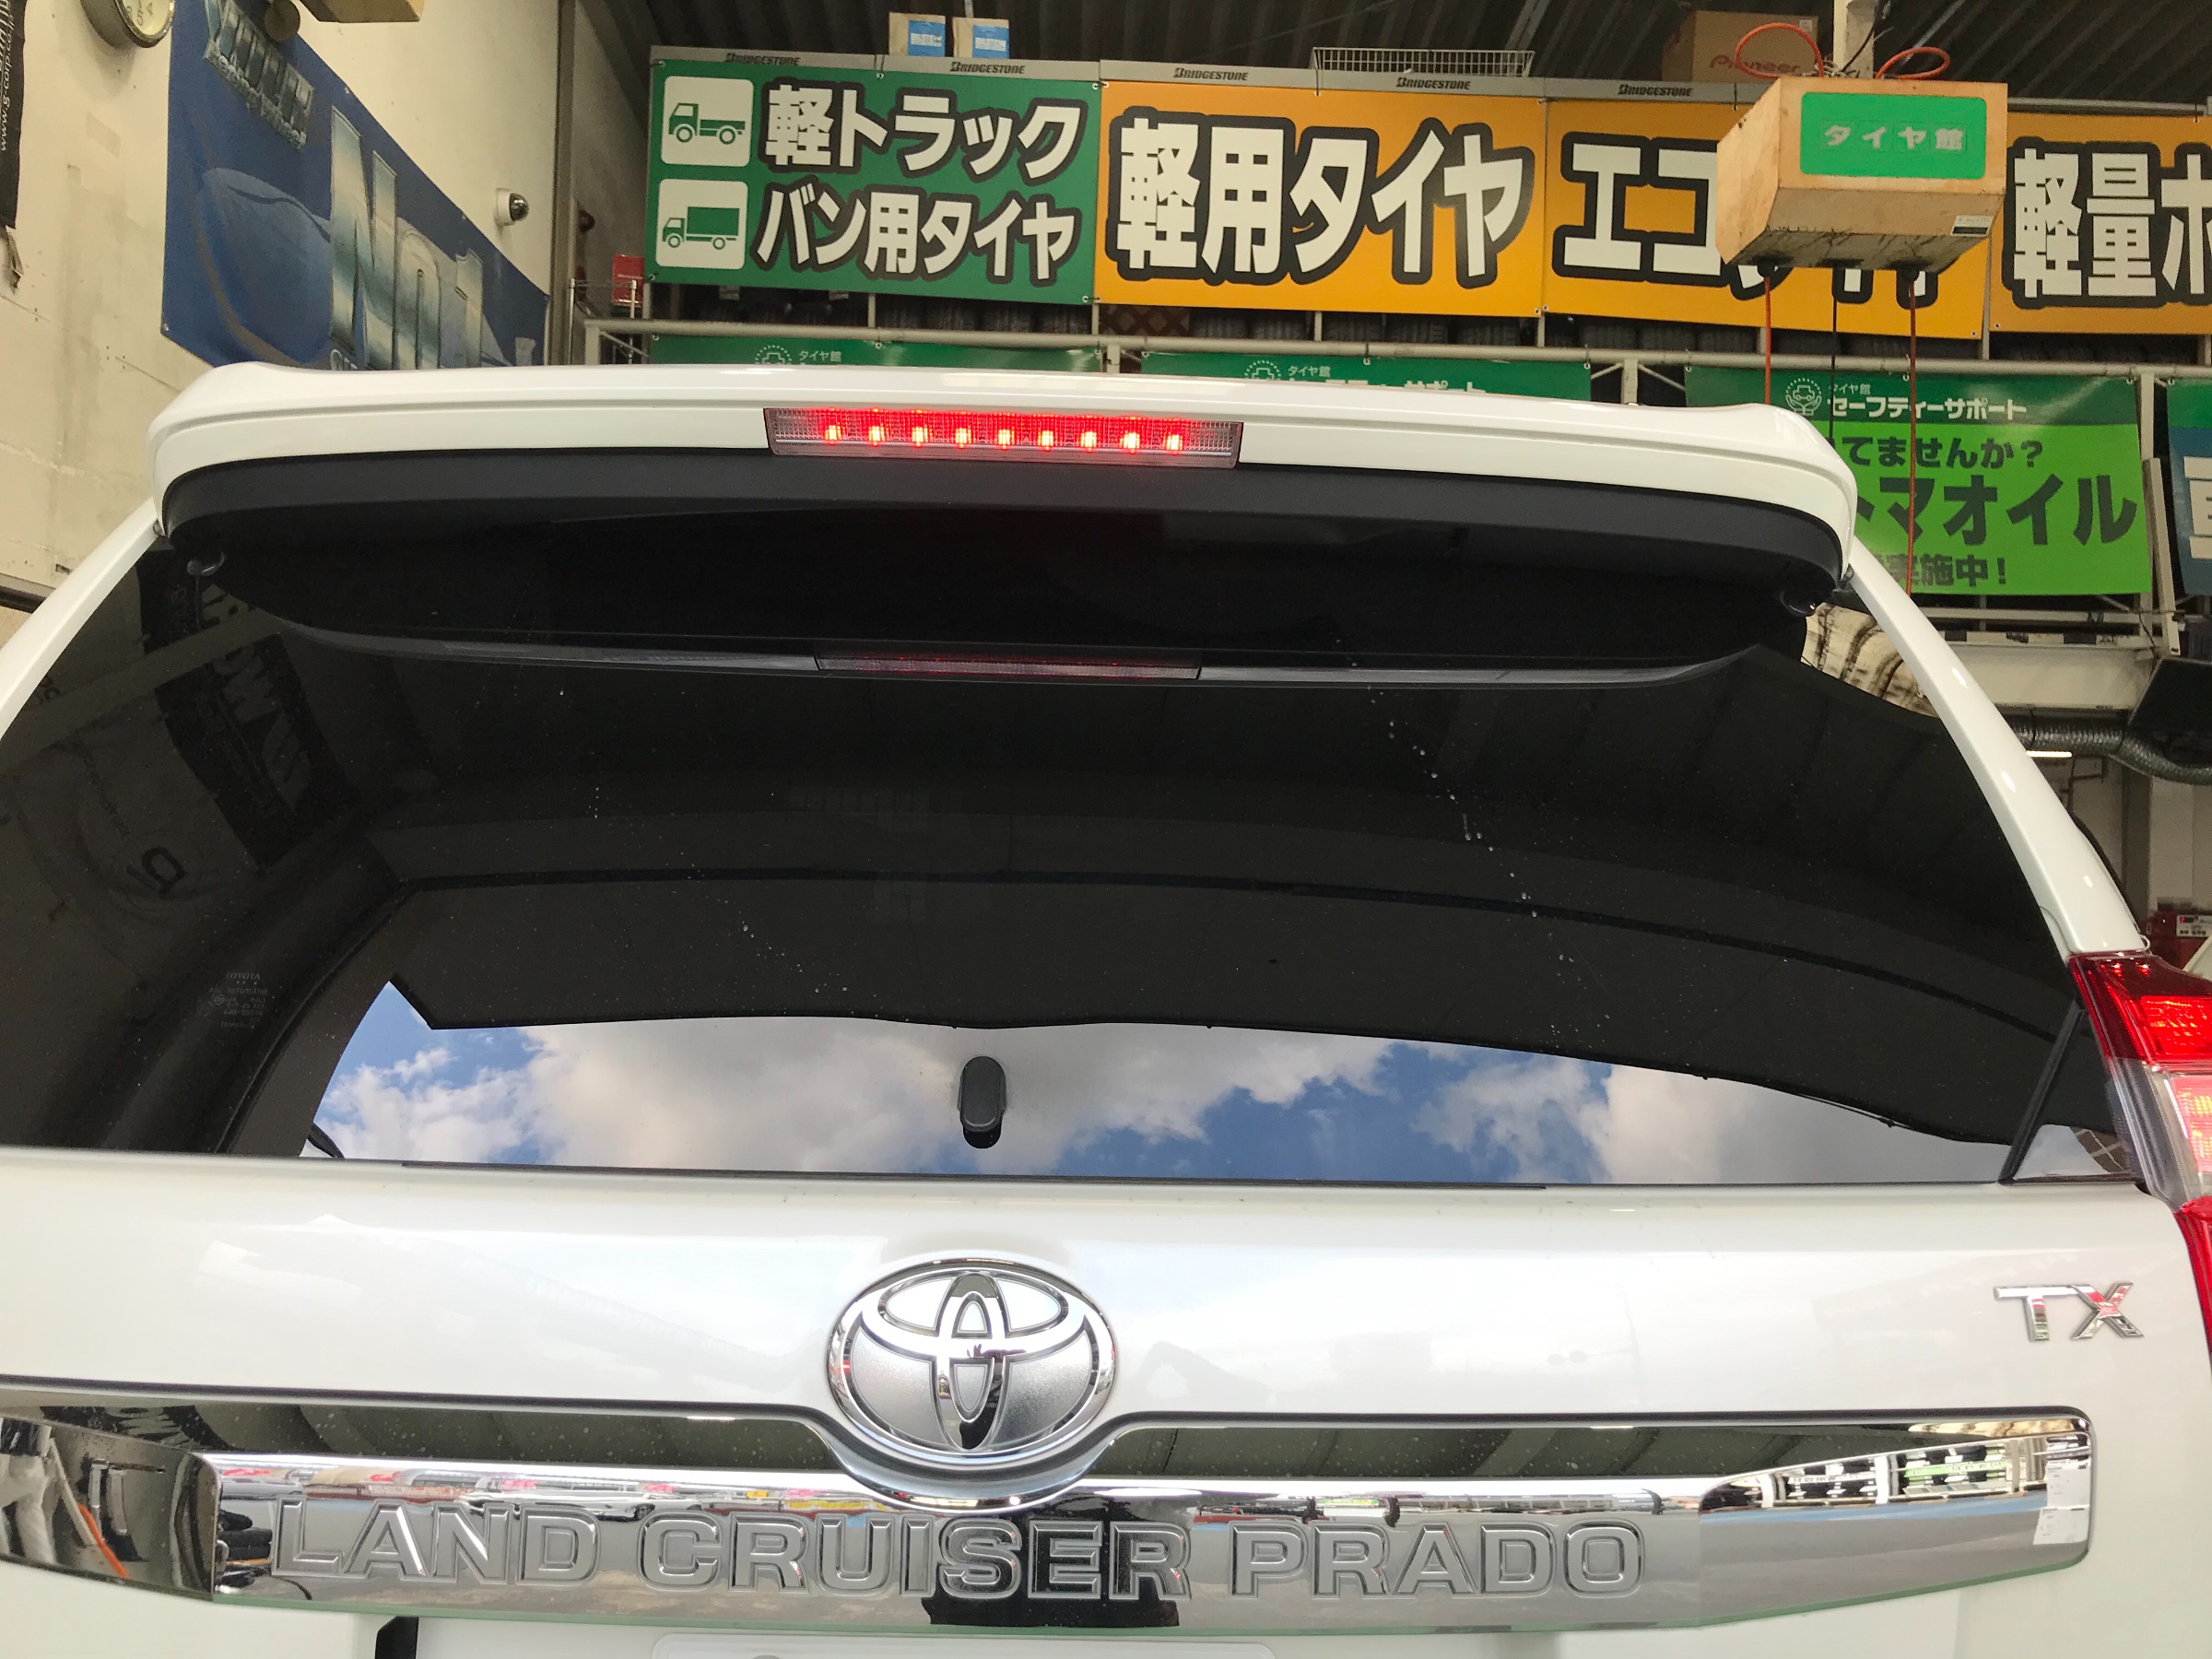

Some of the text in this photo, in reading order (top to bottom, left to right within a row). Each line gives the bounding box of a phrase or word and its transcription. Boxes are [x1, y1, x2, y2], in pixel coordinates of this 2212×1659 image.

[950, 60, 1026, 75] BRIDGESTONE
[1173, 66, 1249, 81] BRIDGESTONE
[1709, 53, 1800, 74] Pneer
[1396, 76, 1471, 90] BRIDGESTONE
[1617, 83, 1694, 97] BRIDGESTONE
[764, 81, 1083, 181] 軽トラック
[1824, 124, 1965, 151] タイヤ館
[1115, 115, 1524, 278] 軽用タイヤ
[756, 182, 1077, 281] バン用タイヤ
[798, 349, 842, 363] タイヤ館
[1287, 365, 1331, 378] タイヤ館
[1827, 394, 2027, 420] セーフティーサポート
[1828, 436, 2043, 469] てませんか？
[1874, 553, 2006, 587] 実施中！
[1992, 1281, 2145, 1342] TX
[274, 1493, 1646, 1602] LAND CRUISER PRADO
